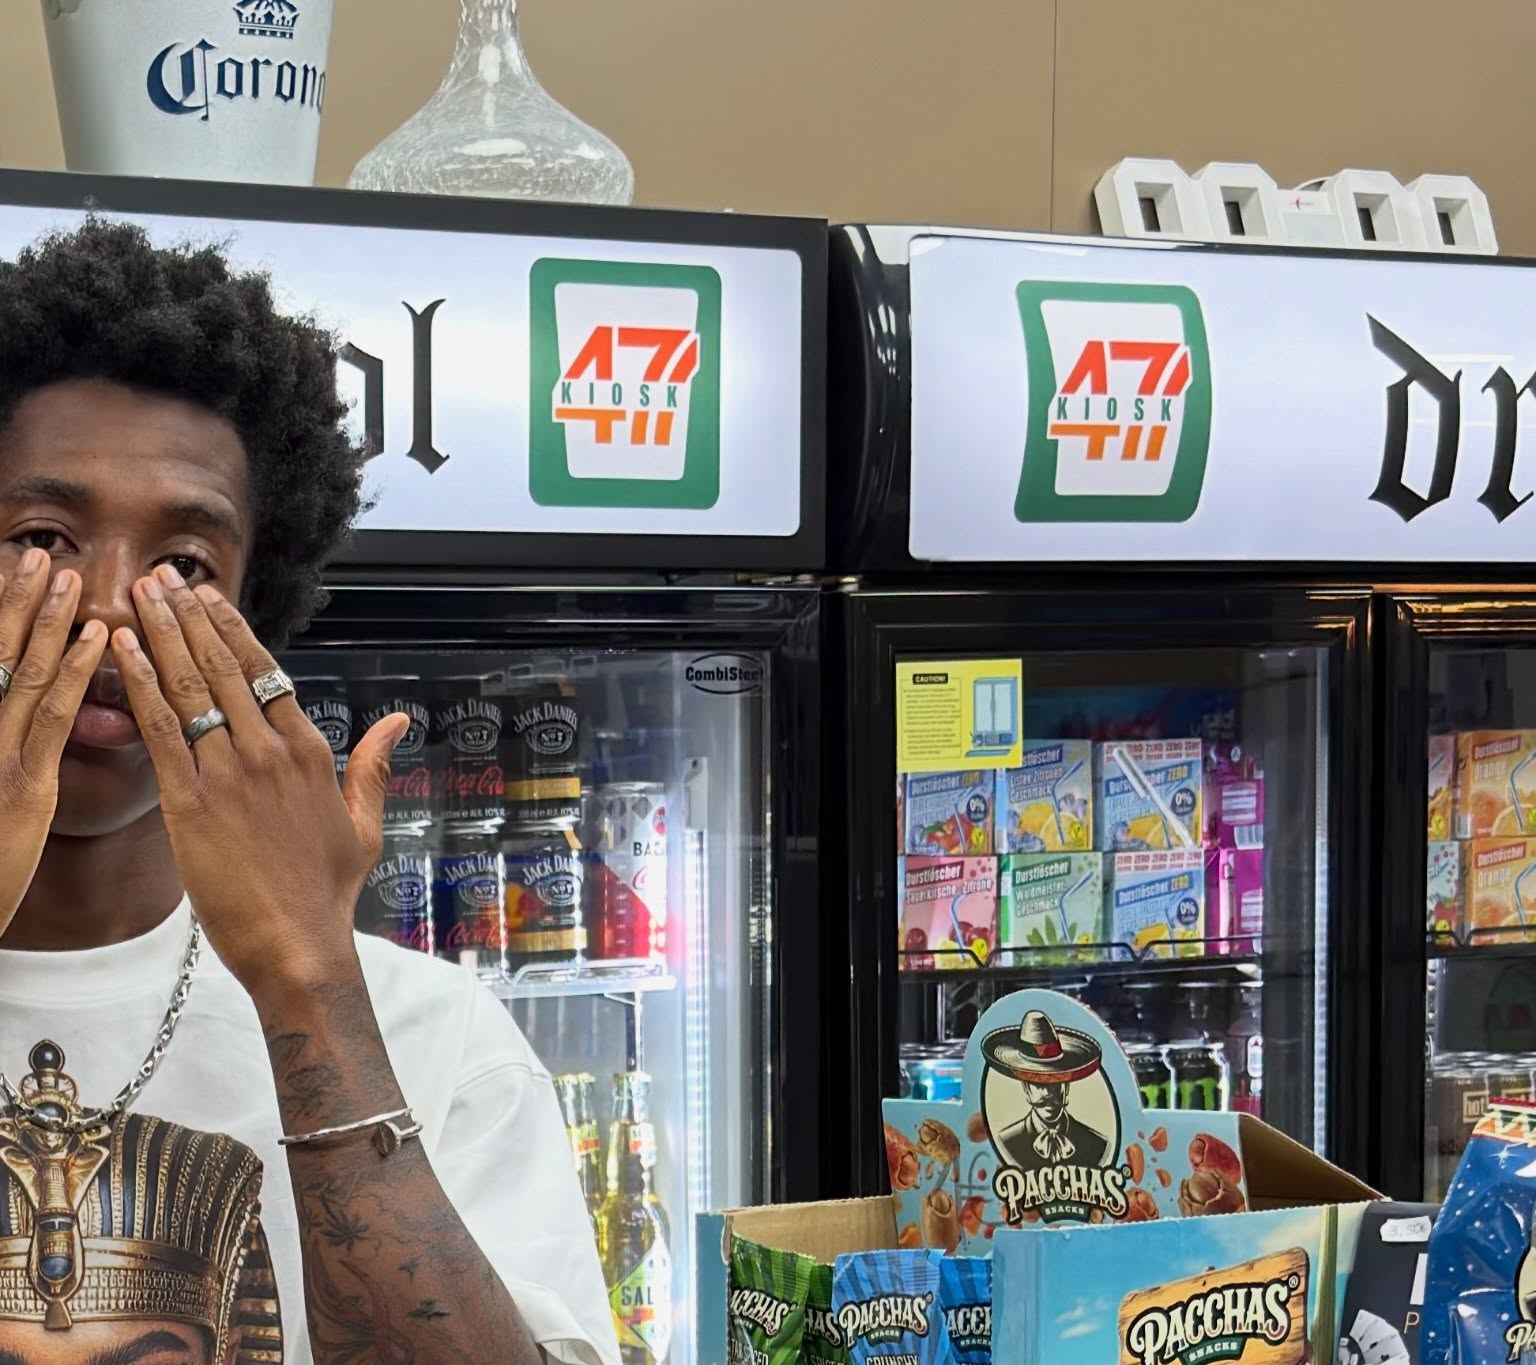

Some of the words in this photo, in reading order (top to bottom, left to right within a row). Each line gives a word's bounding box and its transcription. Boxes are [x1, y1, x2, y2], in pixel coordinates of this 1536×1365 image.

[561, 382, 678, 409] KIOSK
[1057, 396, 1172, 421] KIOSK
[514, 704, 542, 733] JACK
[969, 799, 985, 811] 0%
[1175, 793, 1192, 805] 0%
[1181, 902, 1197, 914] 0%
[994, 1166, 1126, 1222] PACCHAS
[1044, 1205, 1085, 1216] SNACKS
[730, 1289, 789, 1336] ACCHAS
[839, 1295, 929, 1348] PACCHAS
[1188, 1341, 1239, 1362] SNACKS
